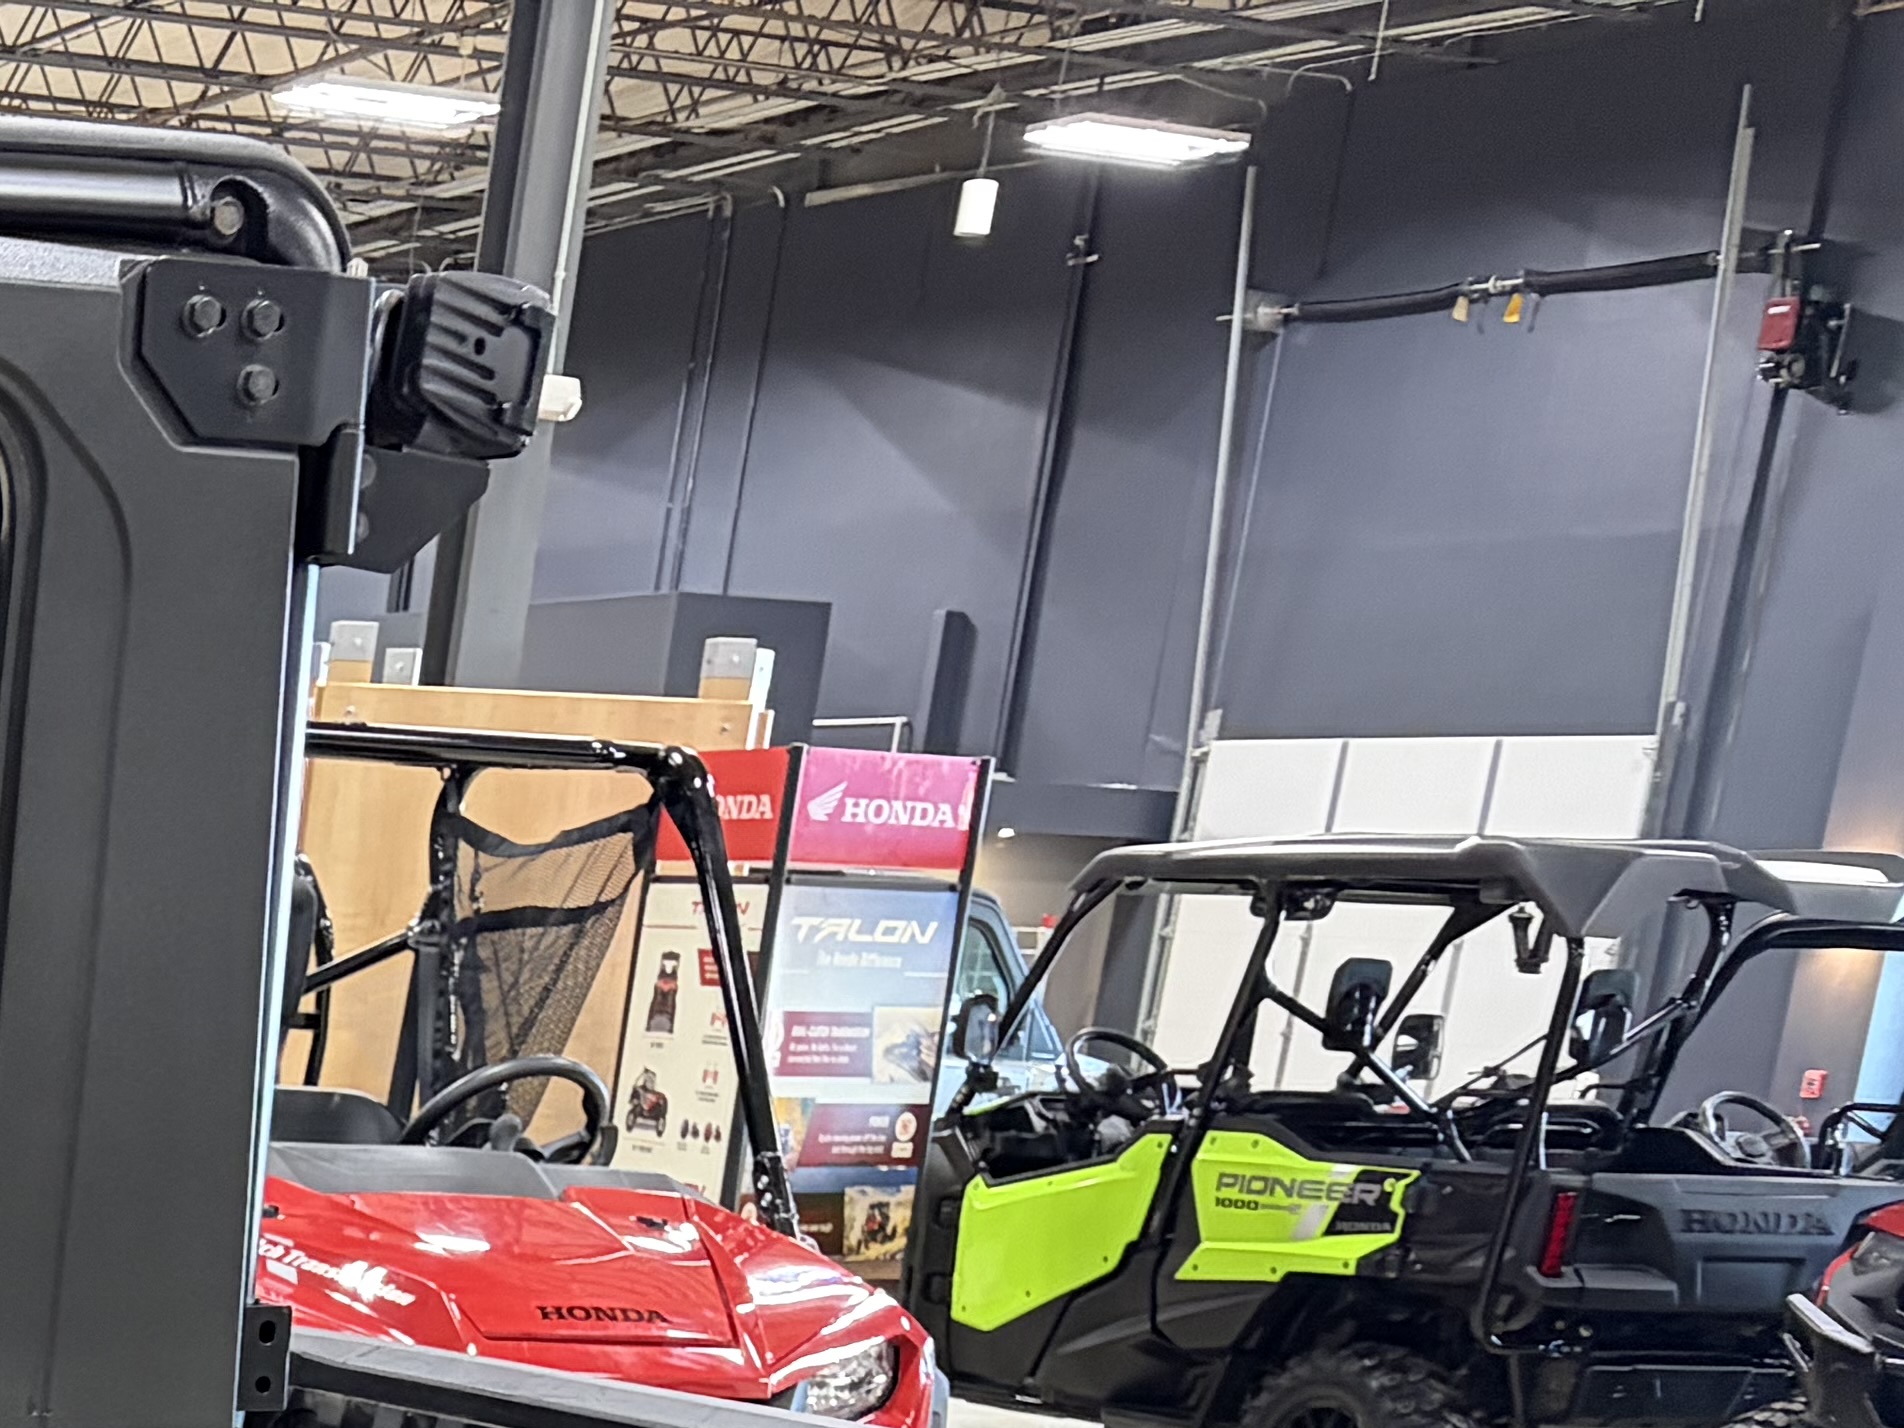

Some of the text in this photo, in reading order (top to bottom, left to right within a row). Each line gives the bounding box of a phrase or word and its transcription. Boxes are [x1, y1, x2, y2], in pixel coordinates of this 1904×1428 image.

[841, 797, 956, 828] HONDA
[791, 916, 939, 945] TALON
[1216, 1172, 1382, 1207] PIONEER
[1215, 1197, 1260, 1211] 1000
[1680, 1209, 1835, 1236] HONDA
[537, 1305, 672, 1325] HONDA
